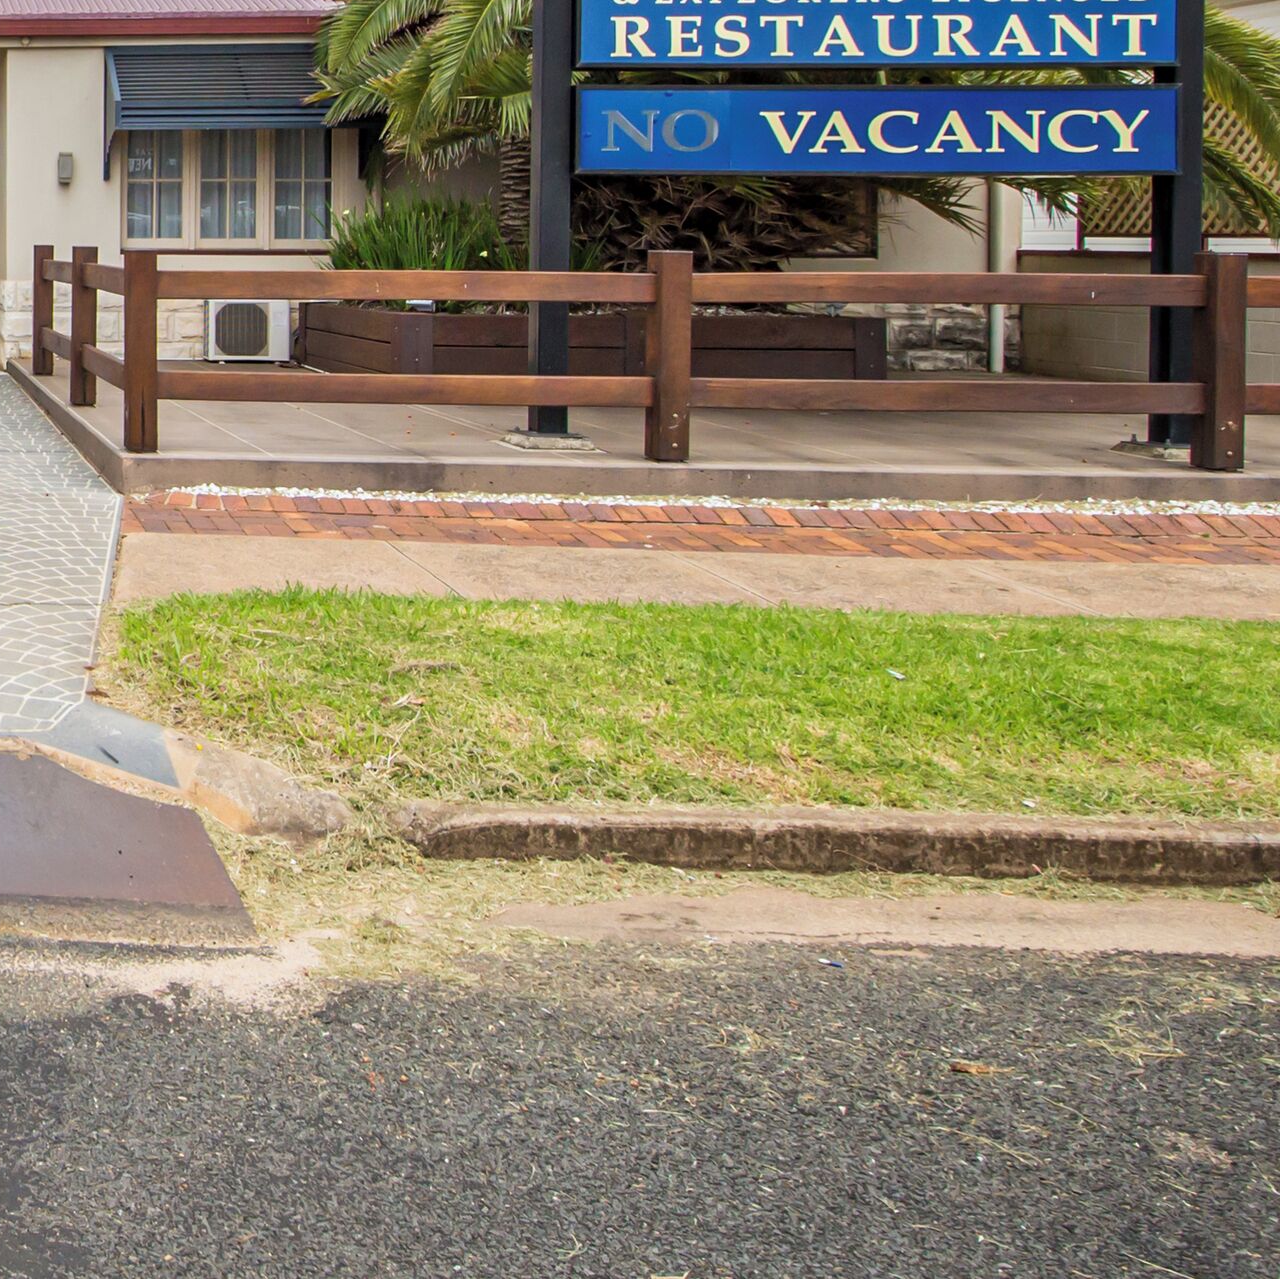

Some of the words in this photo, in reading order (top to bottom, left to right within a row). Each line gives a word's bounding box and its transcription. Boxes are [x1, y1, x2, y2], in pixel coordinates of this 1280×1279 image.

[610, 13, 1158, 58] RESTAURANT
[600, 109, 719, 152] NO
[759, 109, 1150, 154] VACANCY
